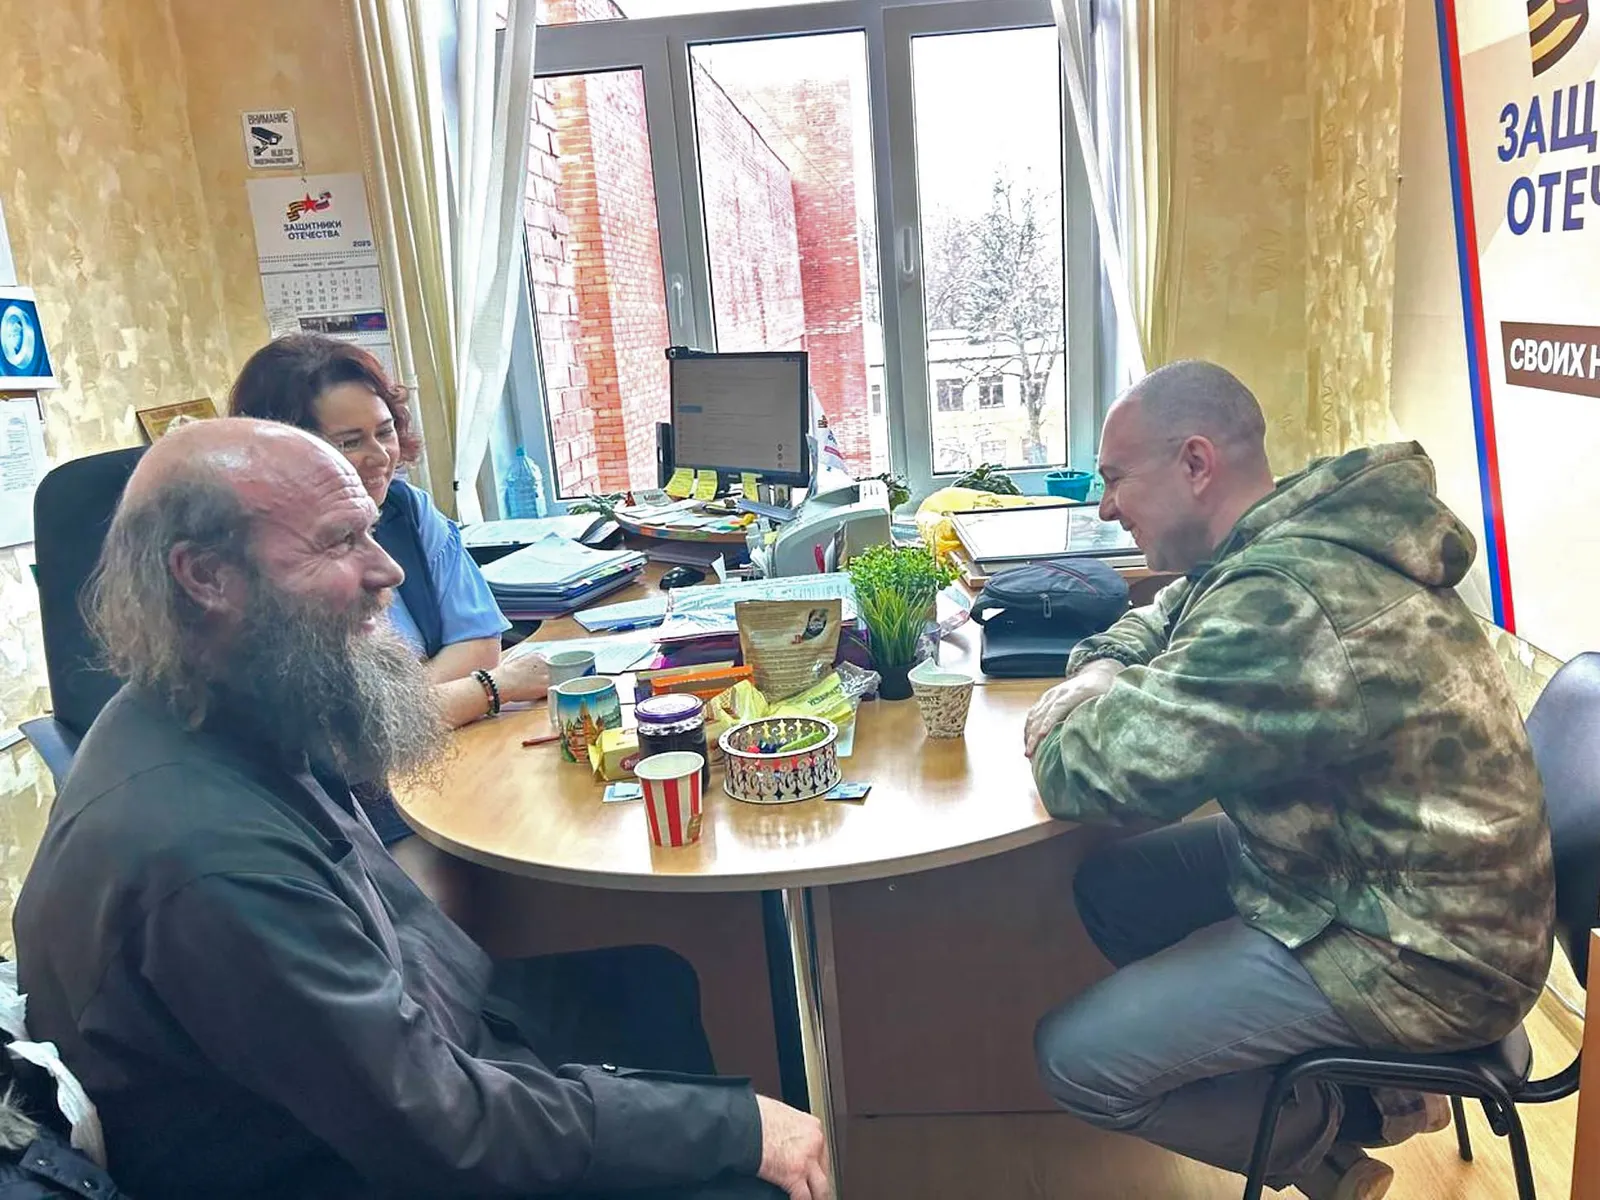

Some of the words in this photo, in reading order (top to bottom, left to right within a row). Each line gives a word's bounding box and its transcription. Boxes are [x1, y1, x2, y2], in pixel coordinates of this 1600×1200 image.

[247, 112, 289, 125] ВНИМАНИЕ
[1497, 80, 1598, 162] ЗАЩ
[284, 220, 342, 231] ЗАЩИТНИКИ
[288, 229, 341, 240] ОТЕЧЕСТВА
[1510, 338, 1587, 378] СВОИХ
